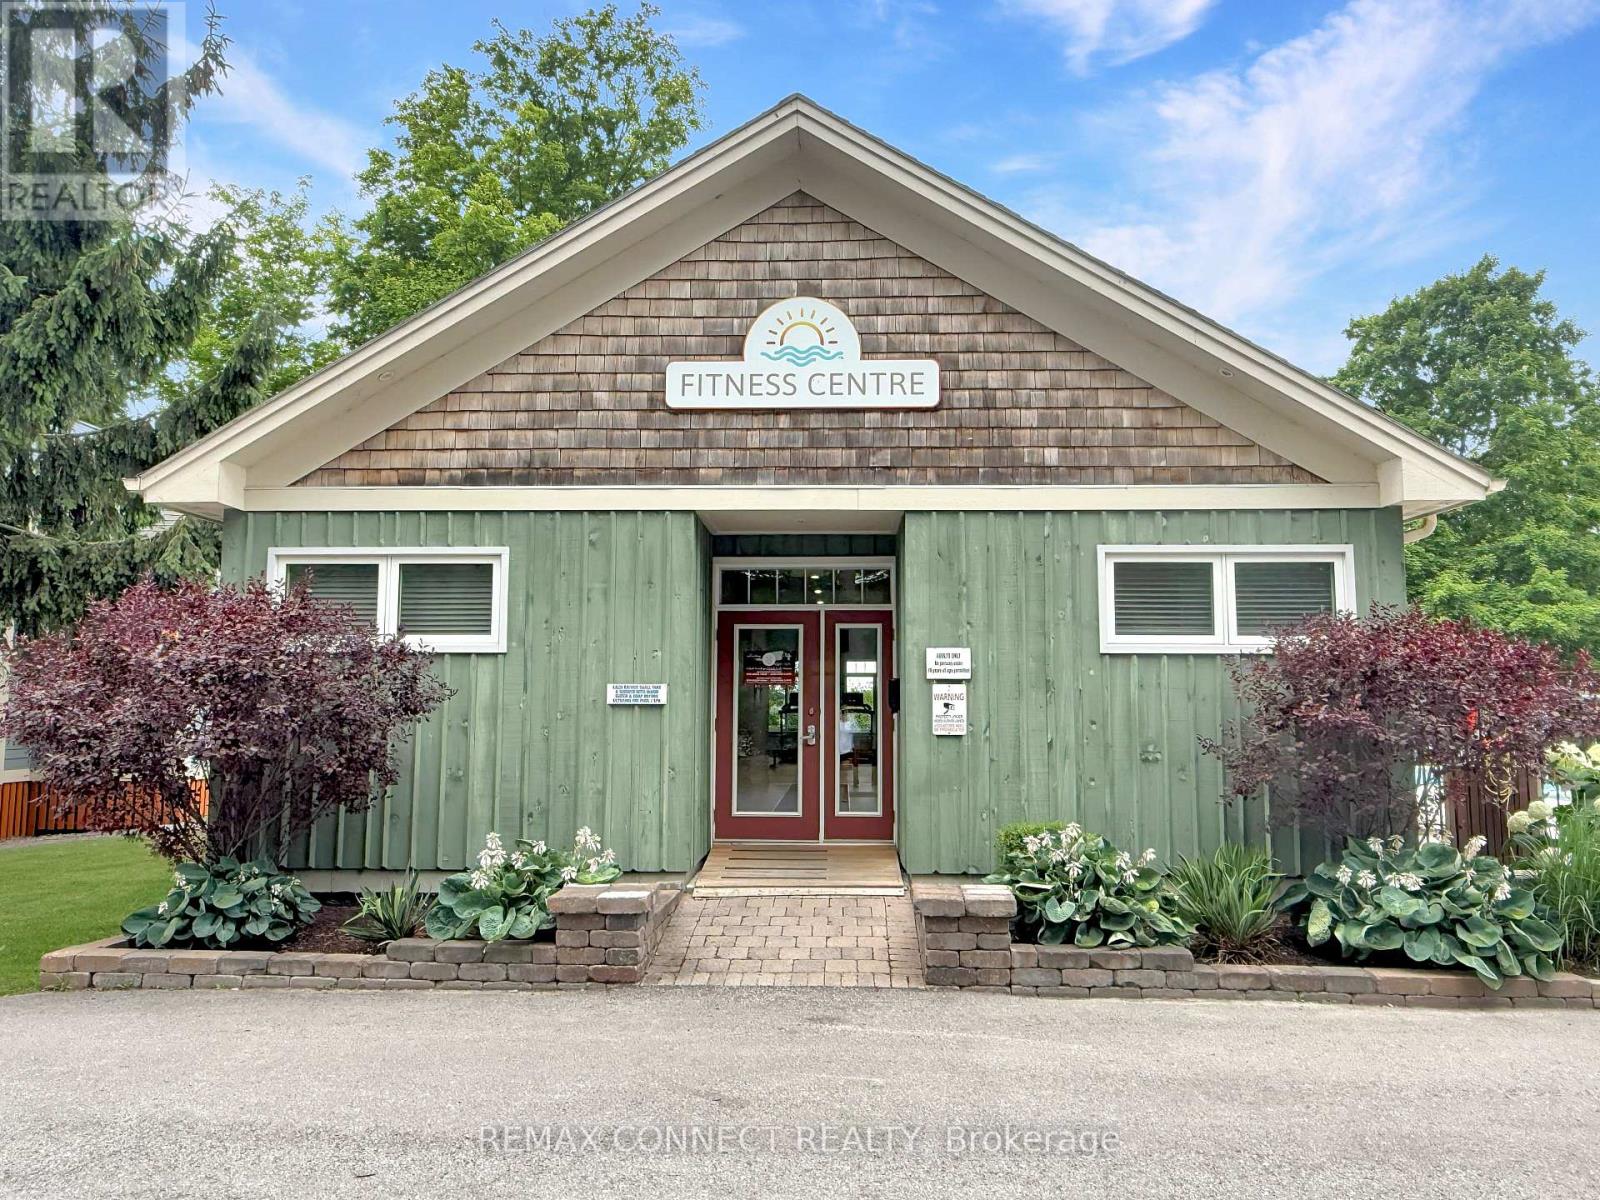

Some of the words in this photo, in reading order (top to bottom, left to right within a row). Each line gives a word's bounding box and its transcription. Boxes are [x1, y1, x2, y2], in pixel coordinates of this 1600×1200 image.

[681, 373, 797, 397] FITNESS
[807, 372, 925, 396] CENTRE
[934, 693, 965, 701] WARNING
